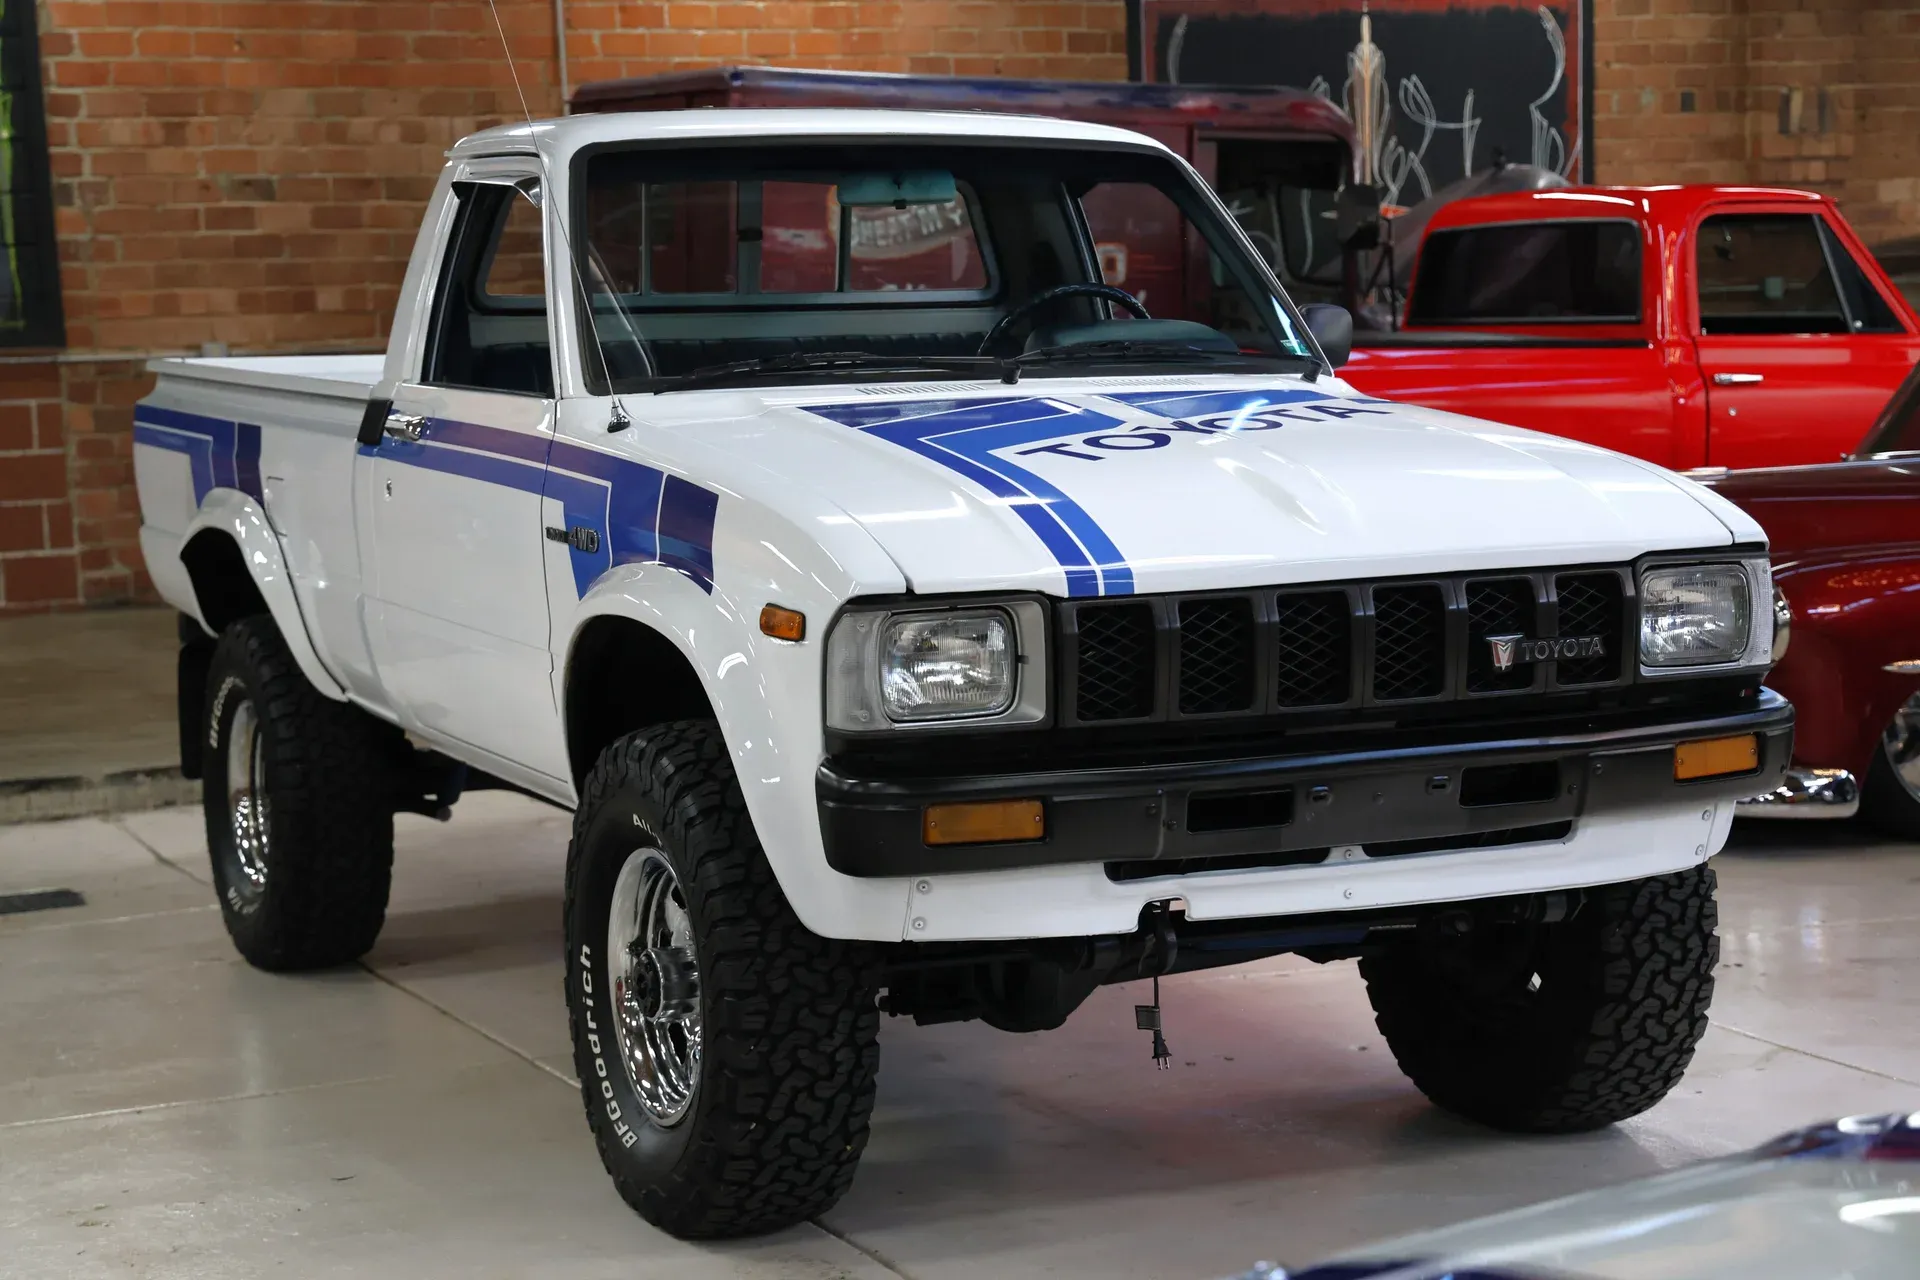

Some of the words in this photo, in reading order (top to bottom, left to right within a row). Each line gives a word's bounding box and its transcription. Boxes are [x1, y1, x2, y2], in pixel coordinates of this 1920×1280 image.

[1014, 403, 1394, 462] TOYOTA
[1521, 637, 1604, 661] TOYOTA
[580, 944, 639, 1149] BFGoodrich
